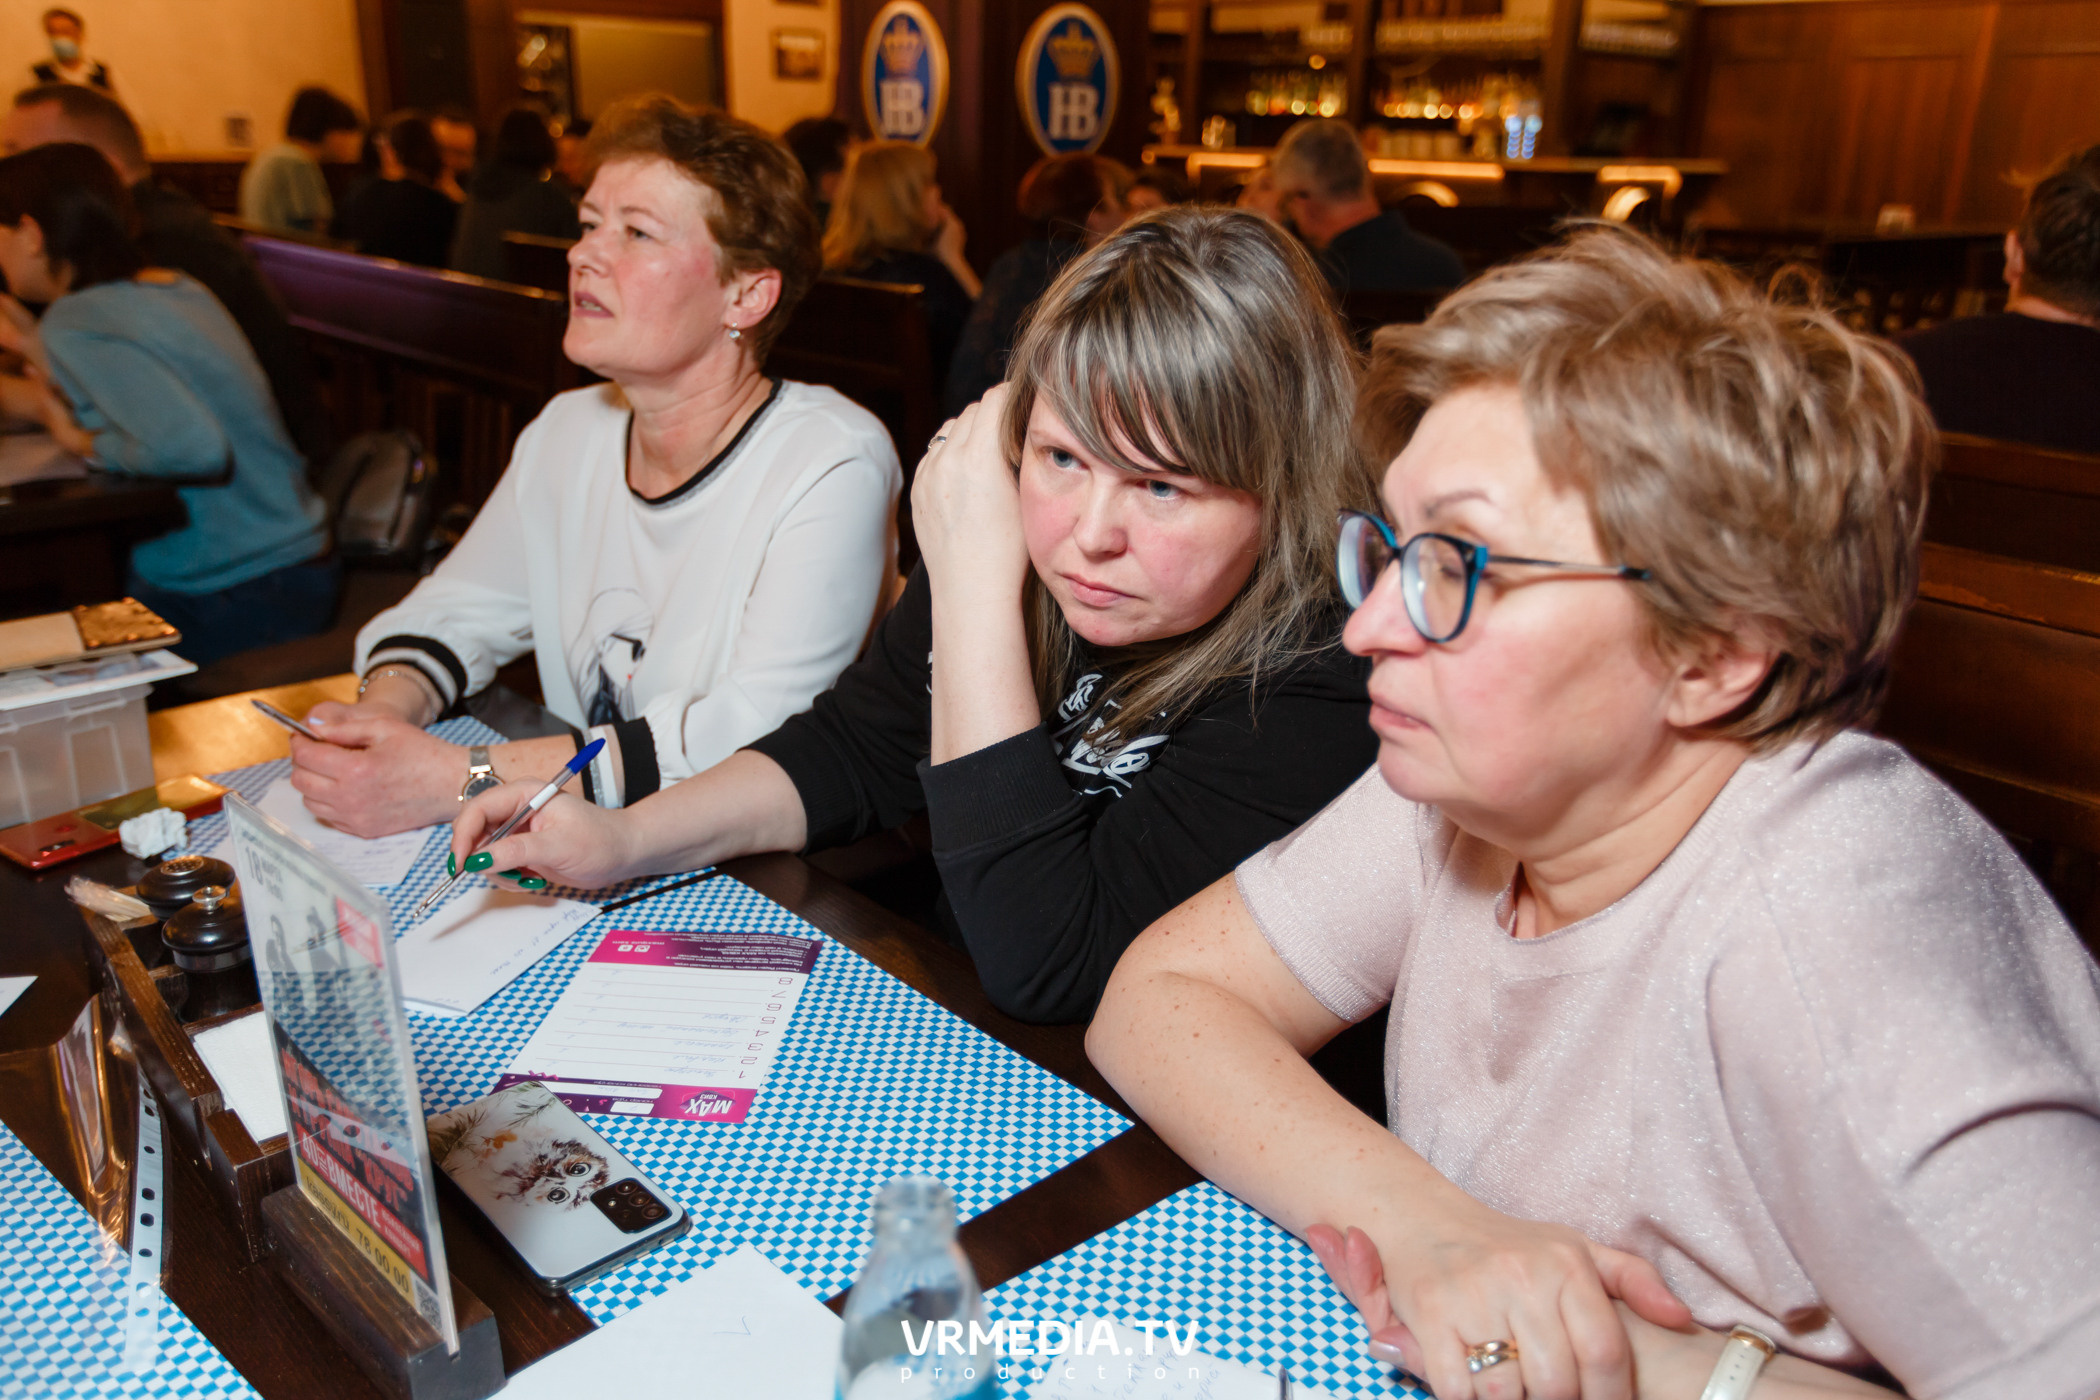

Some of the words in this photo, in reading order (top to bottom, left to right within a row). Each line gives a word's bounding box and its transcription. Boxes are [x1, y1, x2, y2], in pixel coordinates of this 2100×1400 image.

[880, 79, 924, 136] HB
[1047, 83, 1099, 140] HB
[245, 846, 264, 885] 18
[684, 1098, 733, 1117] MAX
[302, 1130, 318, 1168] 40
[326, 1153, 381, 1229] ВМЕСТЕ
[306, 1176, 350, 1233] kassy.ru
[356, 1228, 372, 1255] 78
[375, 1247, 390, 1274] 00
[393, 1270, 409, 1294] 00
